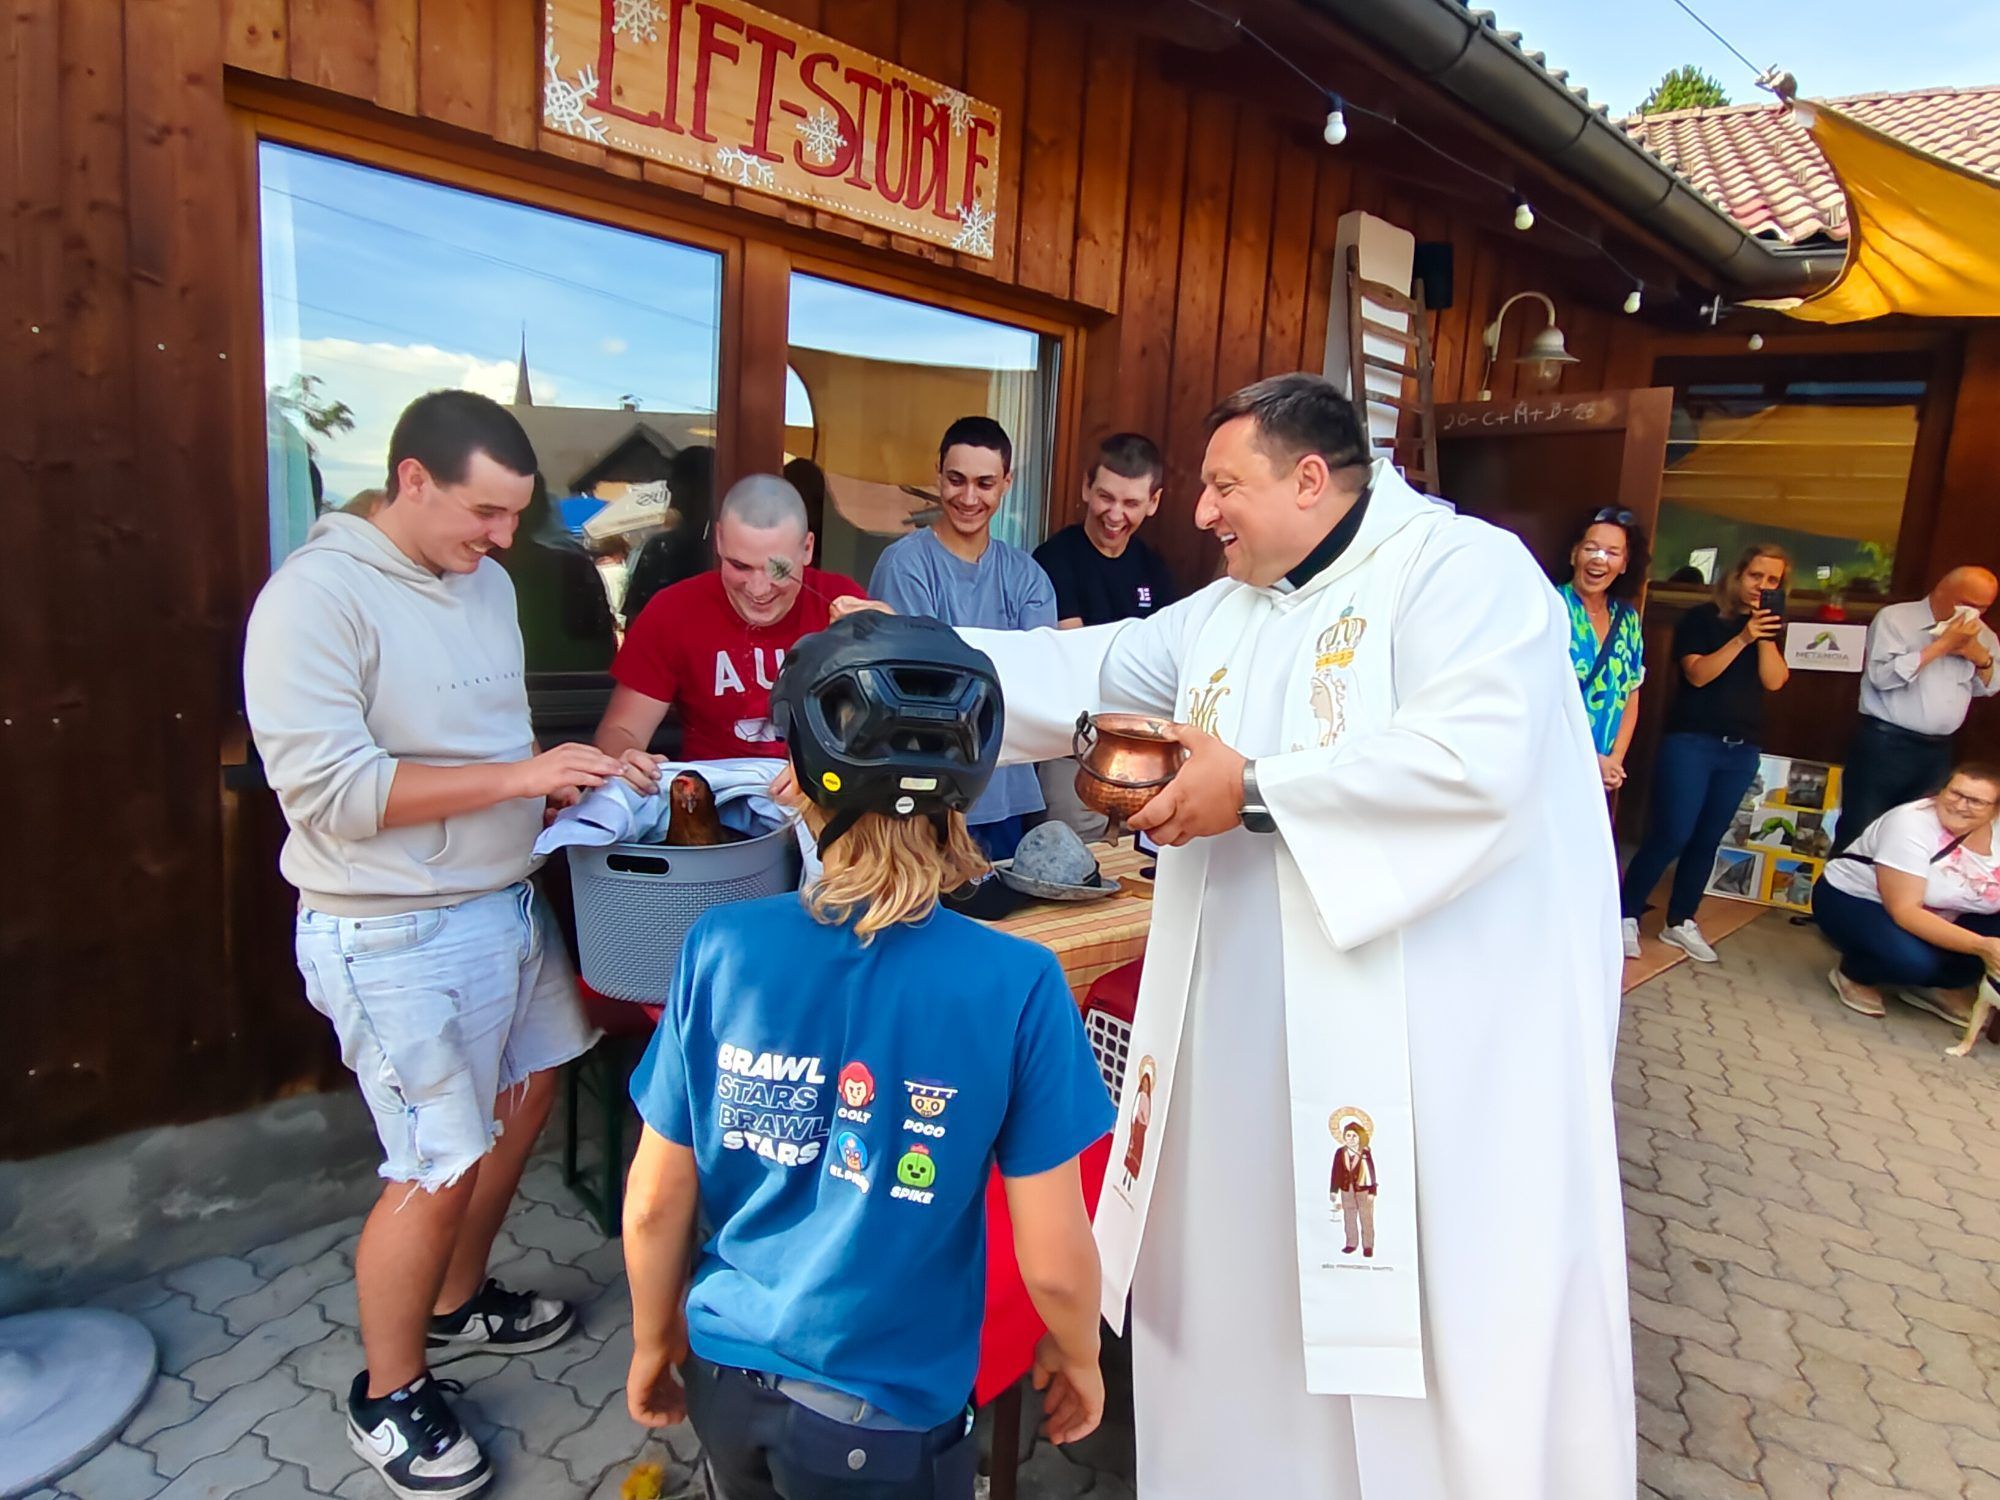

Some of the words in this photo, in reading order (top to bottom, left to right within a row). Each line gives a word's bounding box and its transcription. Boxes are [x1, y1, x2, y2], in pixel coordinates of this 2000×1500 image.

[718, 1043, 826, 1084] BRAWL
[718, 1074, 818, 1111] STARS
[719, 1103, 830, 1140] BRAWL
[836, 1107, 873, 1125] COLT
[902, 1119, 946, 1138] POCO
[723, 1131, 821, 1167] STARS
[890, 1185, 935, 1204] SPIKE
